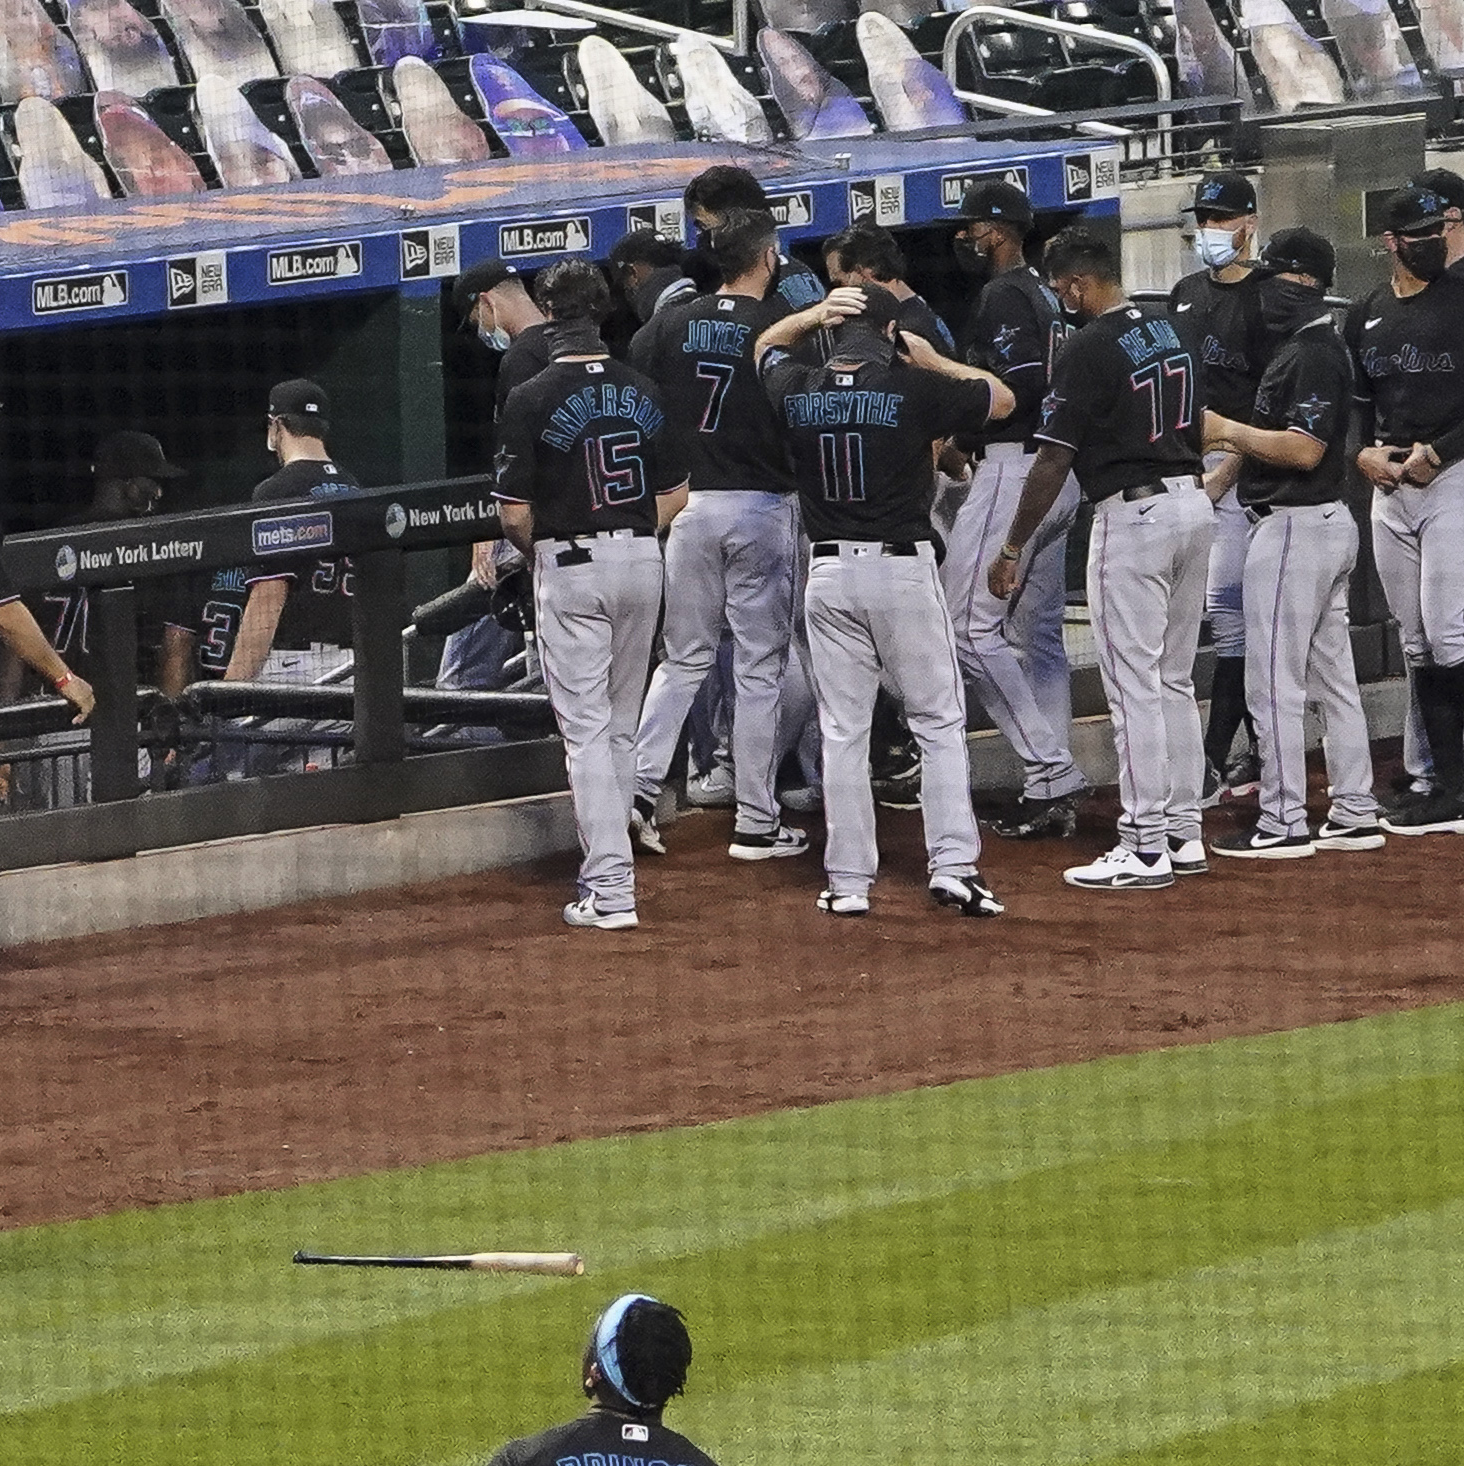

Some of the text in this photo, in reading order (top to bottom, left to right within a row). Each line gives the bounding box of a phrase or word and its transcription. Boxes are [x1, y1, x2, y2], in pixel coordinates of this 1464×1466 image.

[880, 186, 900, 199] NEW
[881, 200, 900, 215] ERA
[435, 237, 456, 251] NEW
[502, 230, 565, 252] MLB.com
[201, 264, 222, 278] NEW
[271, 254, 335, 280] MLB.com
[435, 251, 456, 265] ERA
[37, 283, 101, 309] MLB.com
[201, 279, 223, 294] ERA
[682, 319, 751, 357] JOYCE
[695, 361, 734, 433] 7
[785, 390, 904, 427] FORSYTHE
[1129, 353, 1194, 443] 77
[540, 384, 665, 452] ANDERSON
[584, 431, 645, 511] 15
[819, 433, 865, 501] 11
[409, 510, 440, 527] New
[443, 504, 475, 521] York
[257, 524, 328, 547] mets.com
[80, 540, 204, 570] New York Lottery
